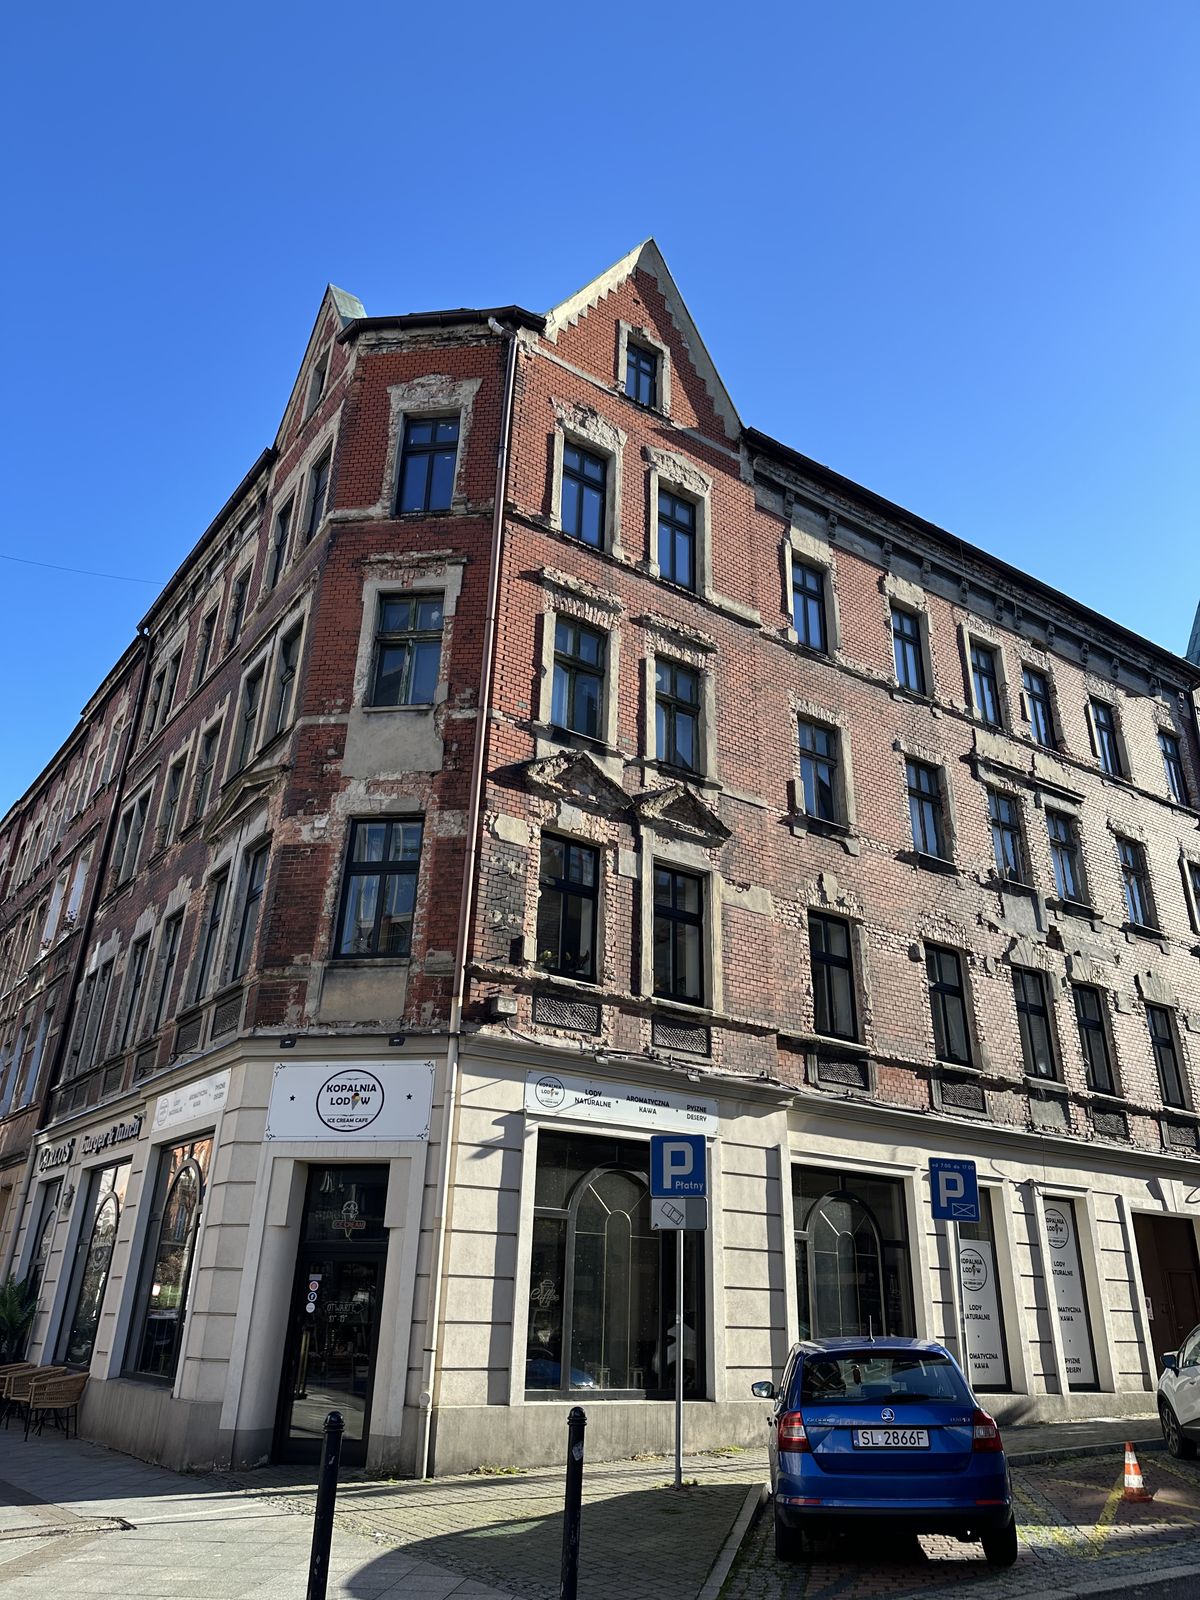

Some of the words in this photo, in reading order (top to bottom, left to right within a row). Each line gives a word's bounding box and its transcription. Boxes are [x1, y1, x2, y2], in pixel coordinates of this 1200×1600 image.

[326, 1083, 377, 1093] KOPALNIA
[585, 1089, 603, 1097] LODY
[575, 1097, 612, 1108] NATURALNE
[626, 1095, 670, 1108] AROMATYCZNA
[639, 1106, 657, 1115] KAWA
[686, 1113, 707, 1123] DESERY
[663, 1142, 693, 1189] P
[675, 1180, 704, 1192] Płatny
[938, 1171, 965, 1207] P
[1046, 1217, 1065, 1225] OPALNIA
[861, 1431, 879, 1446] SL
[884, 1431, 925, 1446] 2866F
